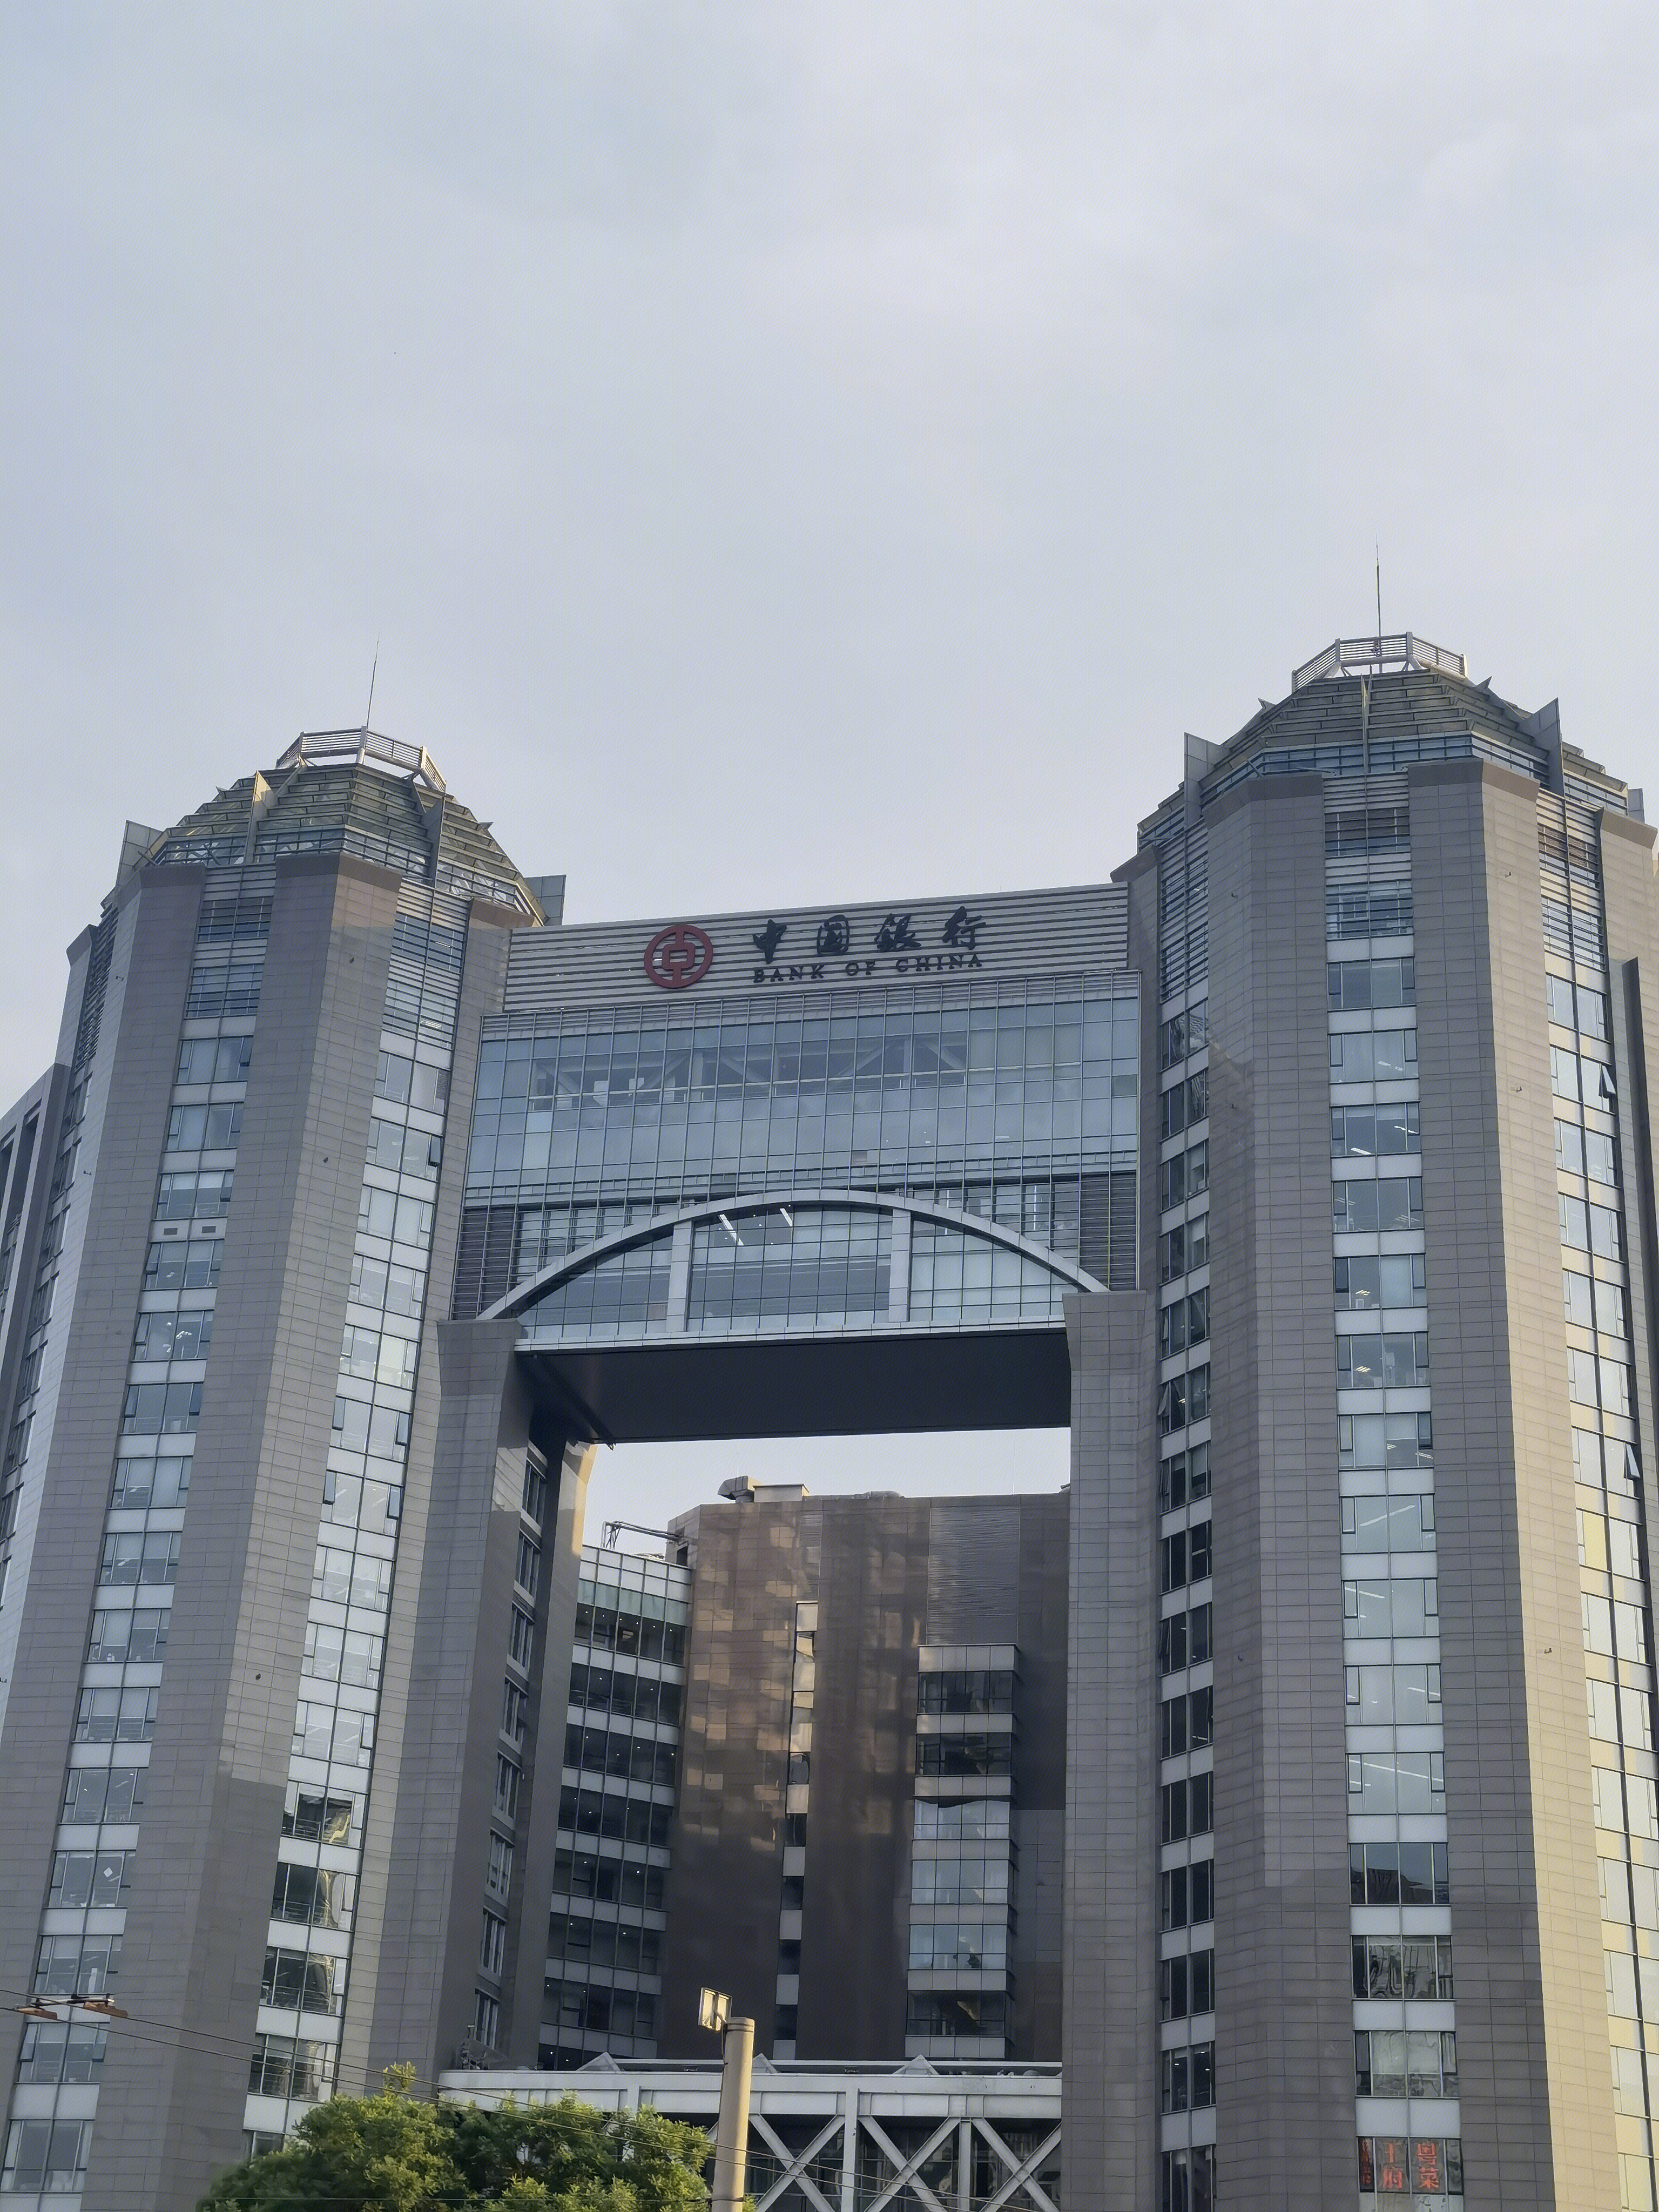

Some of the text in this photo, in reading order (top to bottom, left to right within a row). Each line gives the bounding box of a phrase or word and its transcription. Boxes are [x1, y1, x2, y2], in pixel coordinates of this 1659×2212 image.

[753, 953, 982, 983] BANK OF CHINA
